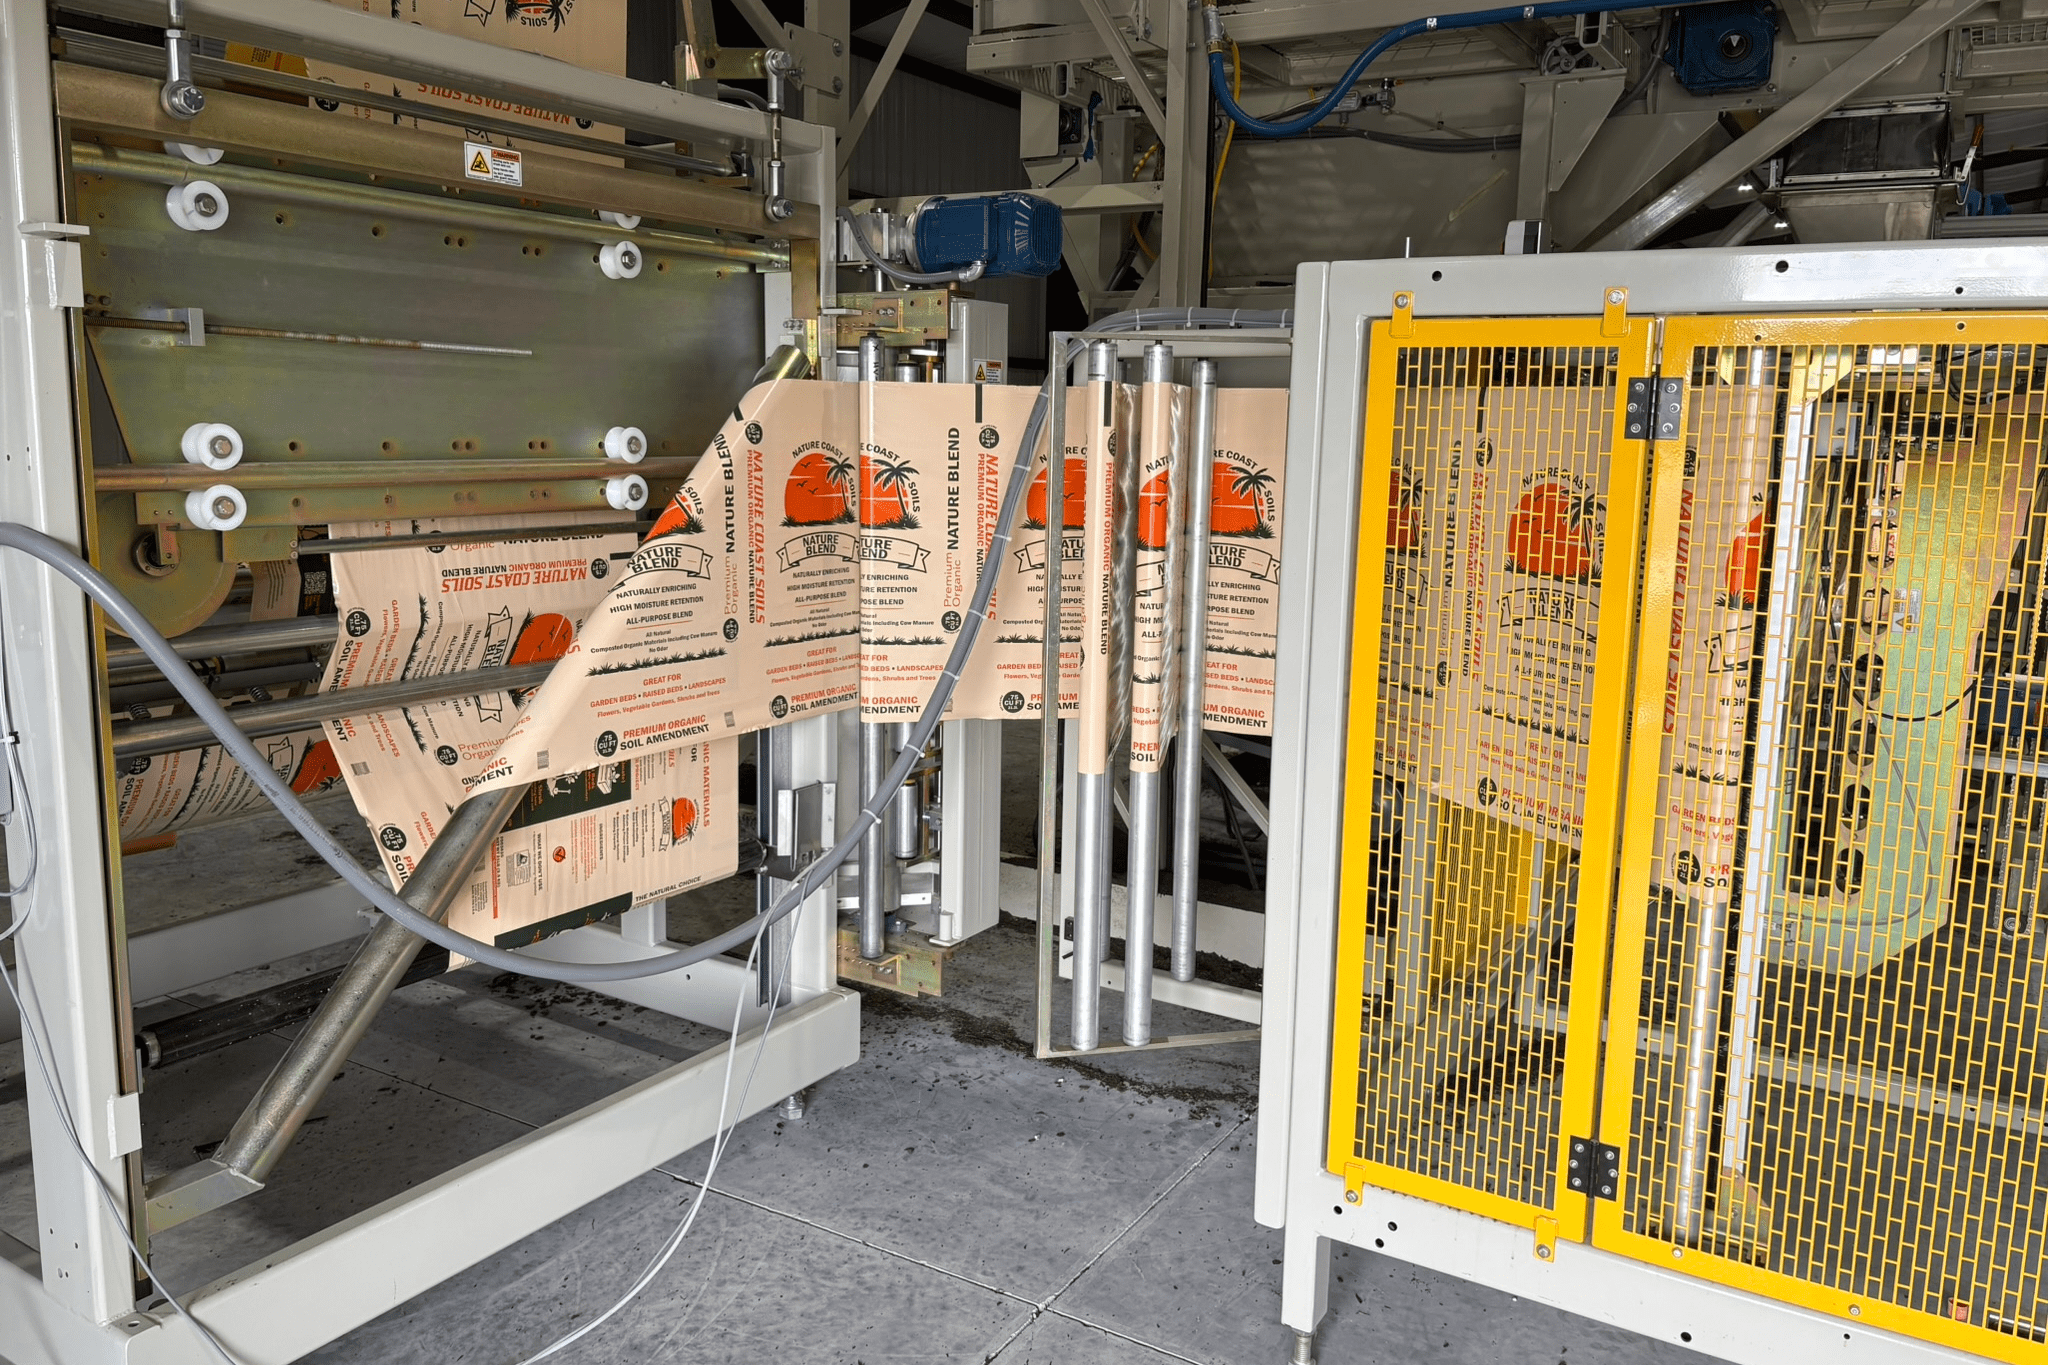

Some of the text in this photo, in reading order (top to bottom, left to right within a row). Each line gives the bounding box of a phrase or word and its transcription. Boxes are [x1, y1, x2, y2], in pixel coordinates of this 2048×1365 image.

[520, 16, 548, 27] SOILS
[792, 441, 820, 458] NATURE
[820, 442, 844, 458] COAST
[866, 443, 900, 462] COAST
[1226, 450, 1258, 470] COAST
[713, 433, 736, 553] NATURE BLEND
[848, 477, 857, 507] SOILS
[908, 482, 920, 512] SOILS
[947, 427, 960, 550] NATURE BLEND
[985, 453, 998, 521] NATURE
[1104, 462, 1113, 518] PREMIUM
[685, 486, 704, 515] SOILS
[1264, 490, 1276, 522] SOILS
[976, 503, 984, 547] ORGANIC
[752, 450, 766, 624] NATURE COAST SOILS
[802, 534, 839, 548] NATURE
[1103, 520, 1112, 572] ORGANIC
[626, 547, 682, 568] NATURE
[806, 544, 836, 556] BLEND
[442, 558, 587, 578] PREMIUM ORGANIC NATURE BLEND
[631, 557, 680, 574] BLEND
[1210, 555, 1242, 568] LEND
[442, 568, 588, 594] NATURE COAST SOILS
[792, 567, 850, 578] NATURALLY ENRICHING
[944, 552, 952, 607] Premium
[616, 583, 697, 600] NATURALLY ENRICHING
[724, 556, 732, 614] Premium
[801, 582, 828, 590] MOISTURE
[828, 579, 856, 587] RETENTION
[952, 560, 962, 607] Organic
[1220, 581, 1261, 591] ENRICHING
[610, 596, 704, 614] HIGH MOISTURE RETENTION
[794, 591, 847, 604] ALL-PURPOSE BLEND
[1101, 574, 1109, 617] NATURE
[1230, 594, 1269, 604] RETENTION
[626, 610, 694, 626] ALL-PURPOSE BLEND
[1230, 608, 1255, 616] BLEND
[338, 640, 354, 665] SOIL
[590, 643, 623, 654] Composted
[624, 641, 643, 650] Organic
[644, 638, 667, 646] Materials
[1222, 663, 1238, 671] FOR
[643, 673, 682, 686] GREAT FOR
[590, 678, 726, 708] GARDEN BEDS RAISED BEDS LANDSCAPES
[791, 684, 856, 704] PREMIUM ORGANIC
[872, 696, 918, 704] ORGANIC
[1231, 686, 1253, 694] Shrubs
[597, 709, 622, 718] Flowers,
[622, 702, 650, 713] Vegetable
[790, 692, 858, 714] SOIL AMENDMENT
[1220, 705, 1265, 718] ORGANIC
[623, 714, 706, 740] PREMIUM ORGANIC
[1203, 712, 1268, 728] MENDMENT
[598, 741, 608, 750] CU
[620, 724, 710, 751] SOIL AMENDMENT
[1130, 752, 1156, 762] SOIL
[122, 777, 134, 800] SOIL
[386, 828, 400, 850] CU FT
[392, 854, 408, 883] SOIL
[636, 876, 702, 902] THE NATURAL CHOICE
